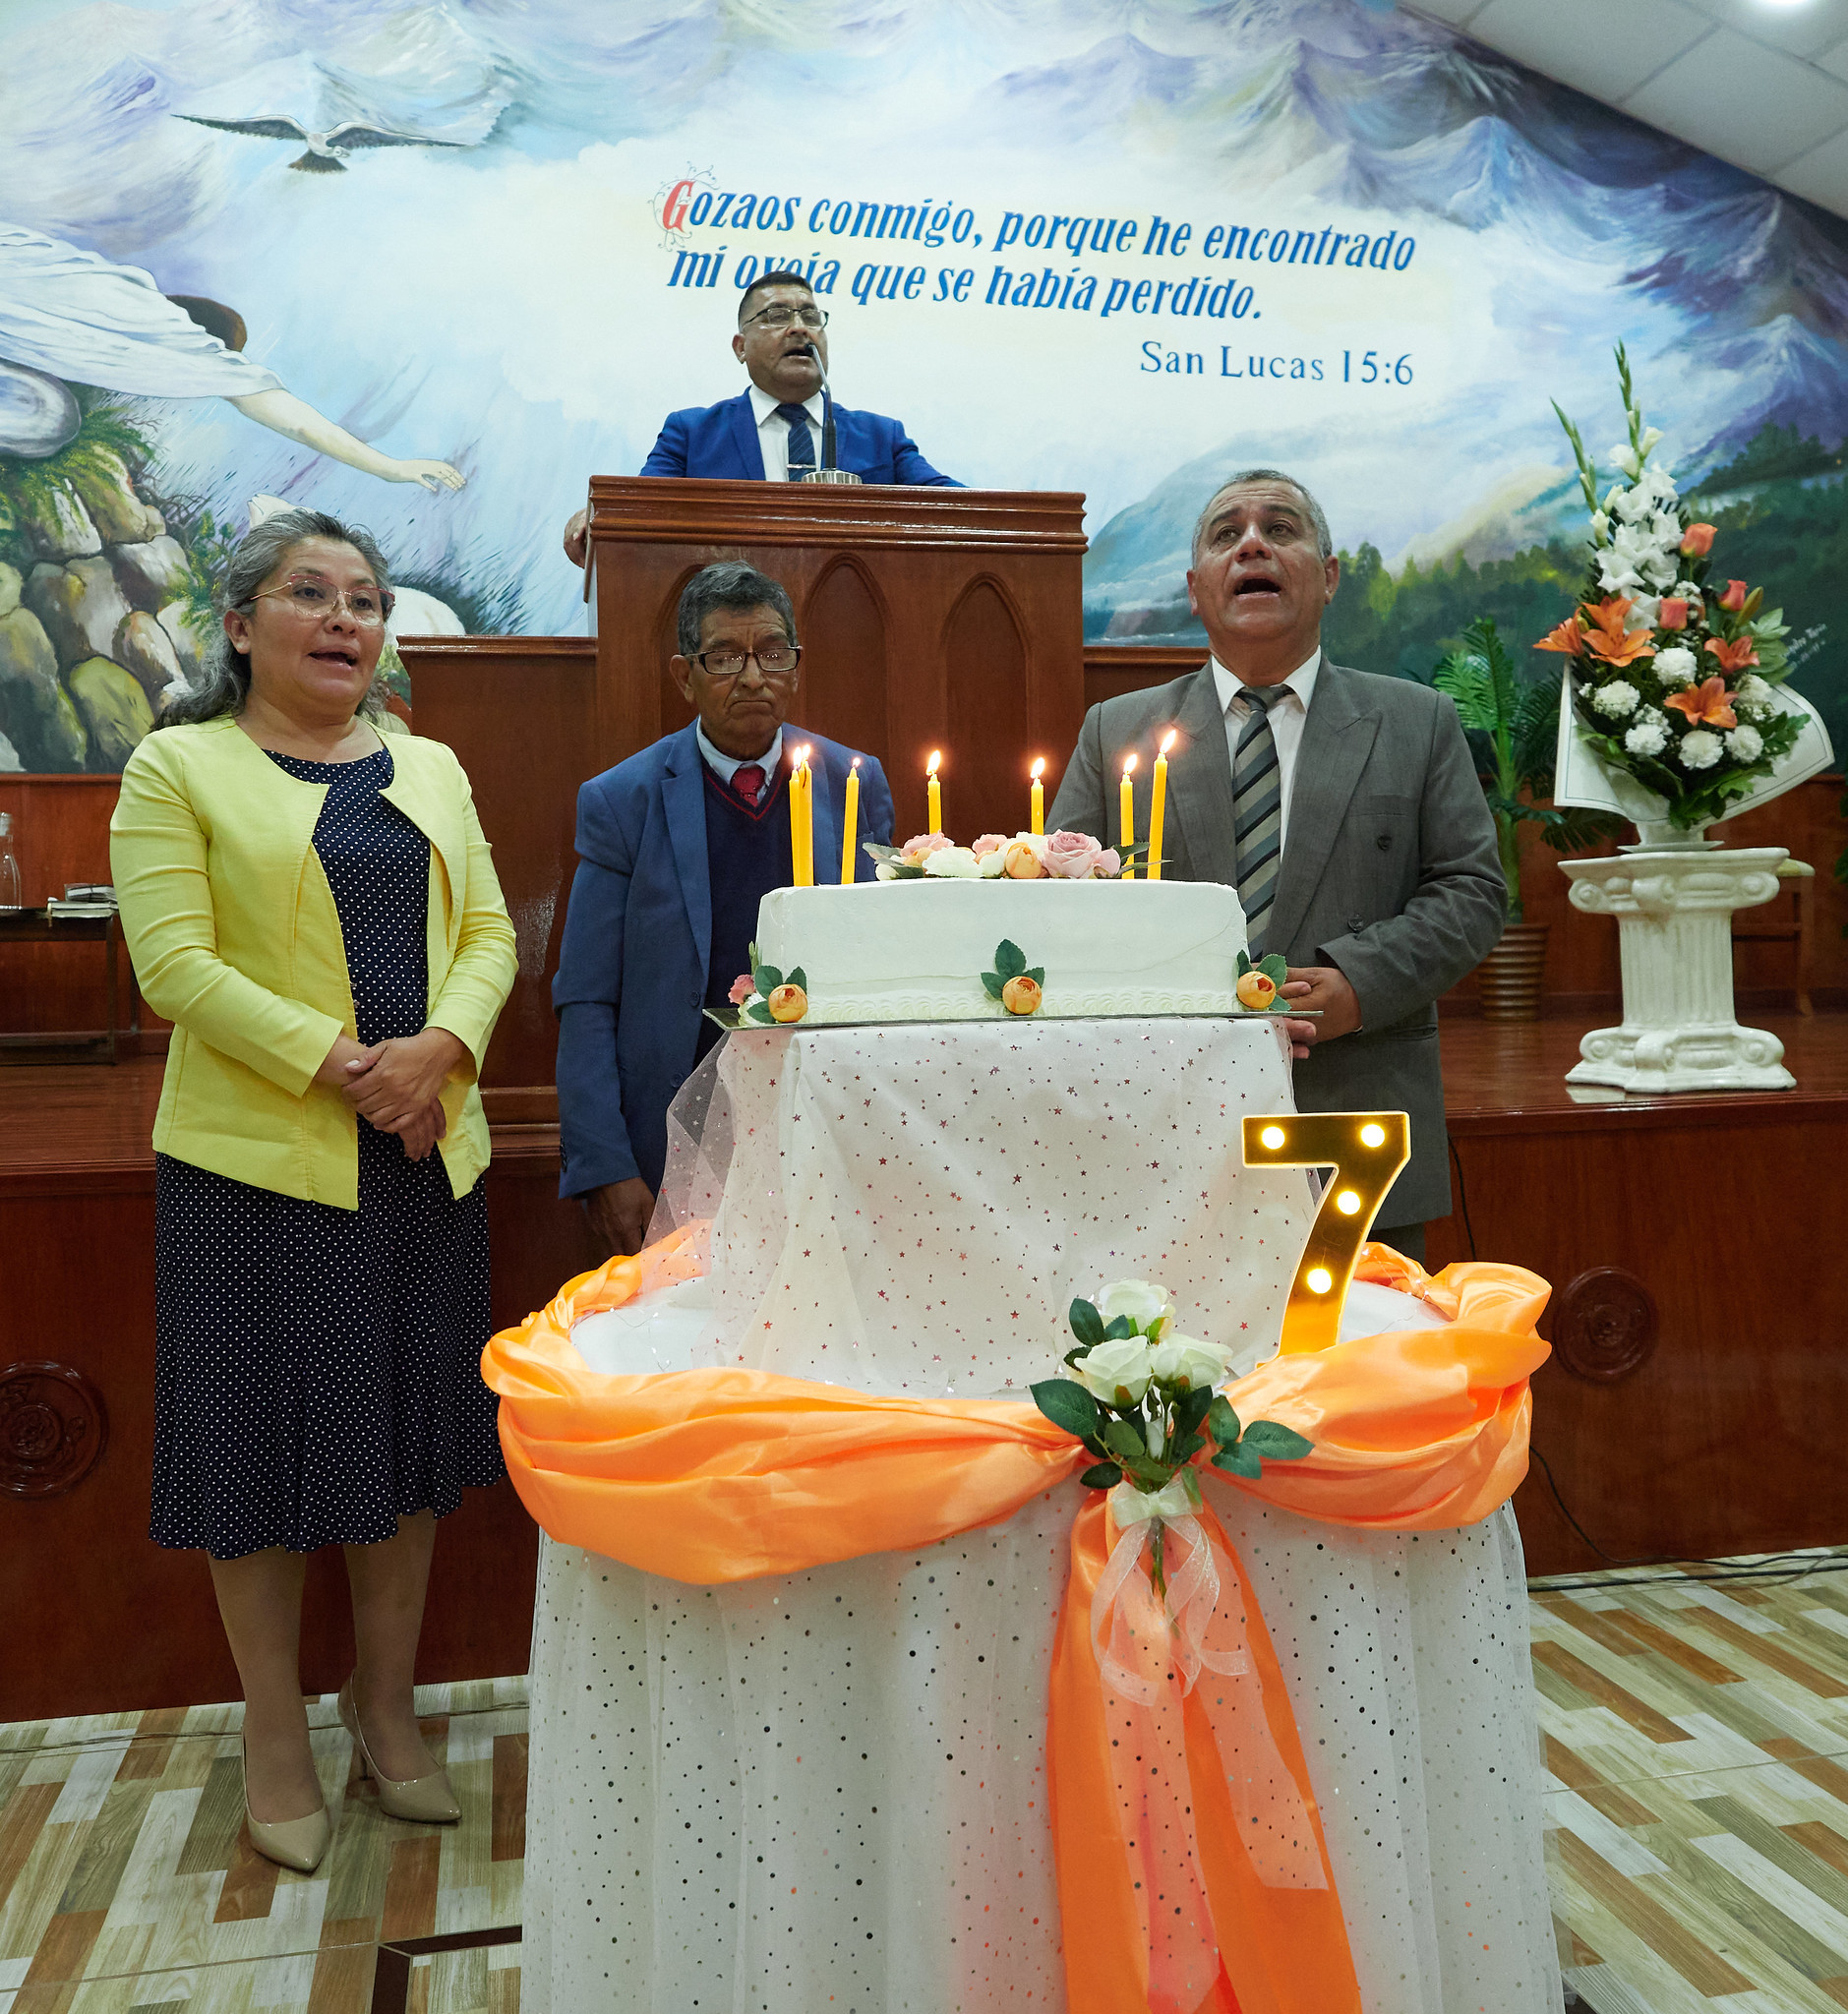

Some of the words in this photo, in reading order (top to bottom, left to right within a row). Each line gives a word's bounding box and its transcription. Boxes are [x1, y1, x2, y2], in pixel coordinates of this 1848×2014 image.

[661, 180, 803, 233] Gozaos
[807, 198, 984, 250] conmigo,
[989, 210, 1139, 259] porque
[1141, 214, 1193, 258] he
[1202, 223, 1417, 272] encontrado
[665, 244, 729, 289] mi
[850, 262, 927, 307] que
[930, 267, 977, 304] se
[984, 264, 1100, 313] había
[1099, 274, 1263, 319] perdido.
[1139, 339, 1206, 376] San
[1219, 344, 1326, 383] Lucas
[1341, 348, 1415, 386] 15:6
[1241, 1110, 1412, 1357] 7
